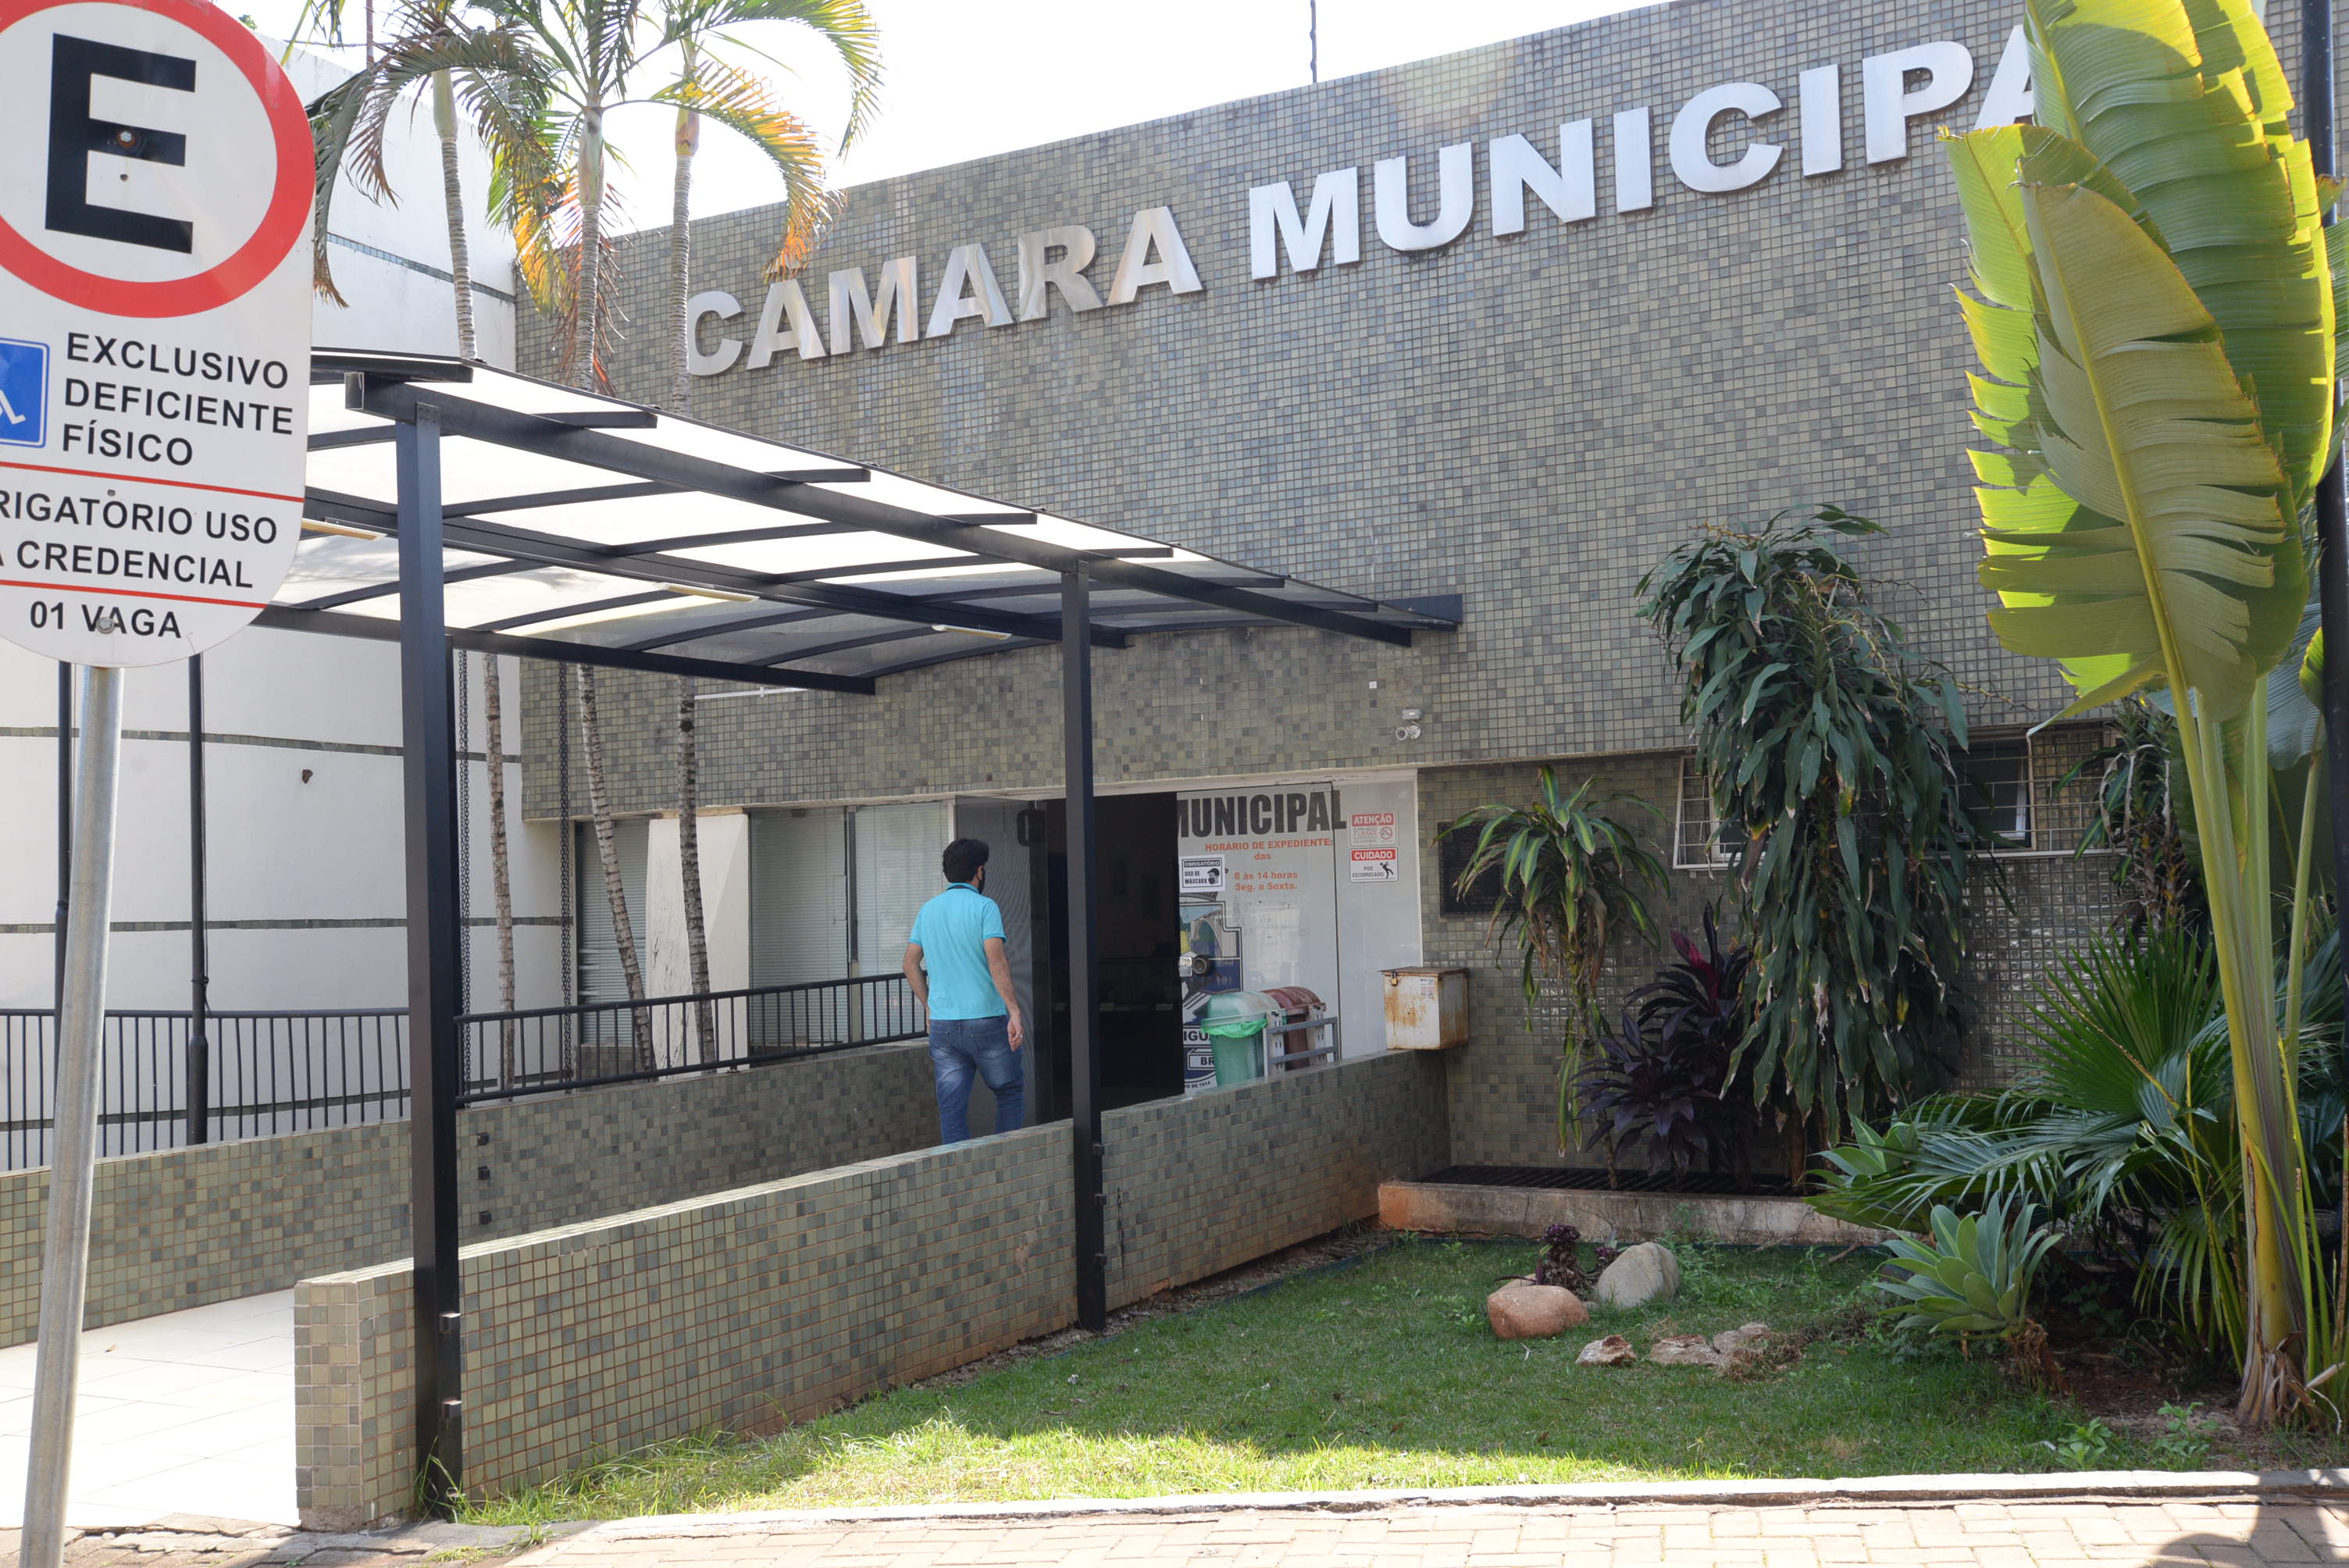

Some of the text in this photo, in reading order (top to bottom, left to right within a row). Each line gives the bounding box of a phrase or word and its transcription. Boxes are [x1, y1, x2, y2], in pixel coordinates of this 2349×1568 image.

[45, 33, 196, 254] E
[688, 205, 1205, 377] CAMARA
[67, 332, 288, 388] EXCLUSIVO
[65, 378, 293, 435] DEFICIENTE
[62, 419, 193, 465] FÍSICO
[206, 511, 276, 544] USO
[17, 540, 253, 589] CREDENCIAL
[30, 600, 182, 639] 01 VAGA
[1205, 838, 1333, 852] HORÁRIO DE EXPEDIENTE:
[1254, 852, 1272, 861] das
[1355, 850, 1393, 860] CUIDADO
[1234, 871, 1240, 880] 8
[1258, 871, 1269, 880] 14
[1235, 883, 1256, 892] Seg.
[1267, 882, 1297, 890] Sexta.
